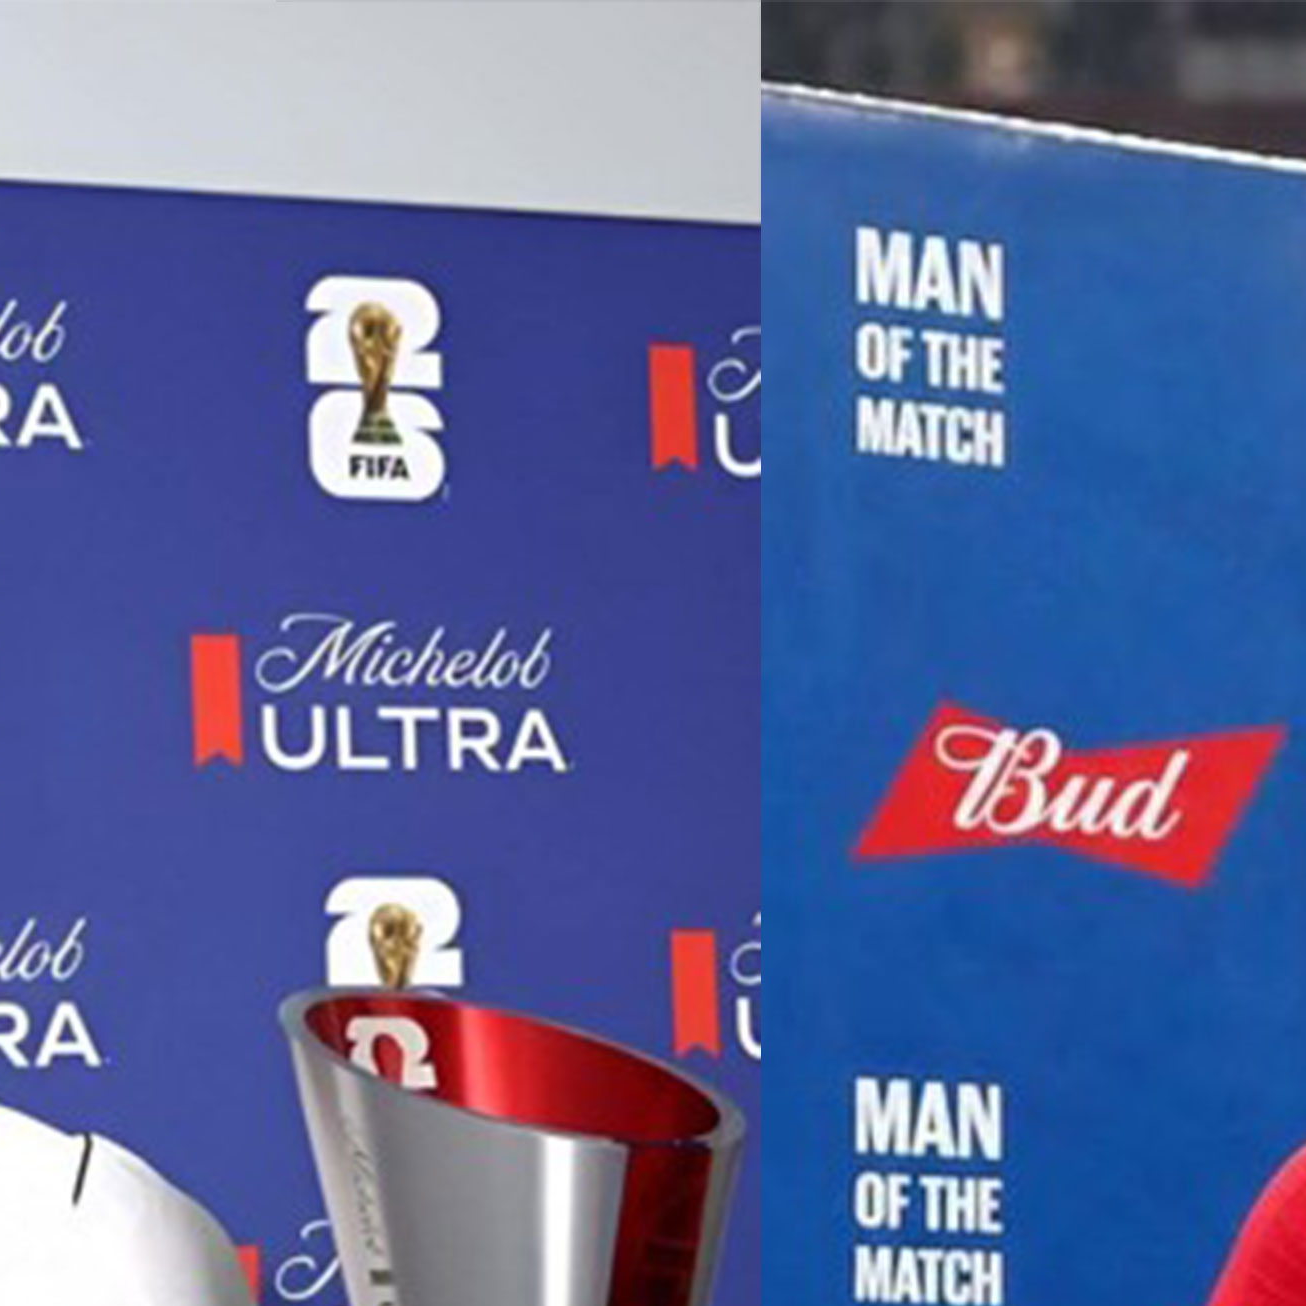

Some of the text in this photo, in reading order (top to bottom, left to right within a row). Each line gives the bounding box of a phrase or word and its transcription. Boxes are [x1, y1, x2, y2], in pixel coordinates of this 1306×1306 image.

[856, 226, 1004, 321] MAN
[856, 323, 1004, 394] OF THE
[349, 454, 410, 480] FIFA
[856, 396, 1005, 467] MATCH
[255, 613, 551, 693] Michelob
[261, 704, 567, 772] ULTRA
[935, 725, 1190, 840] Bud
[854, 1077, 1003, 1161] MAN
[854, 1172, 1003, 1234] OF THE
